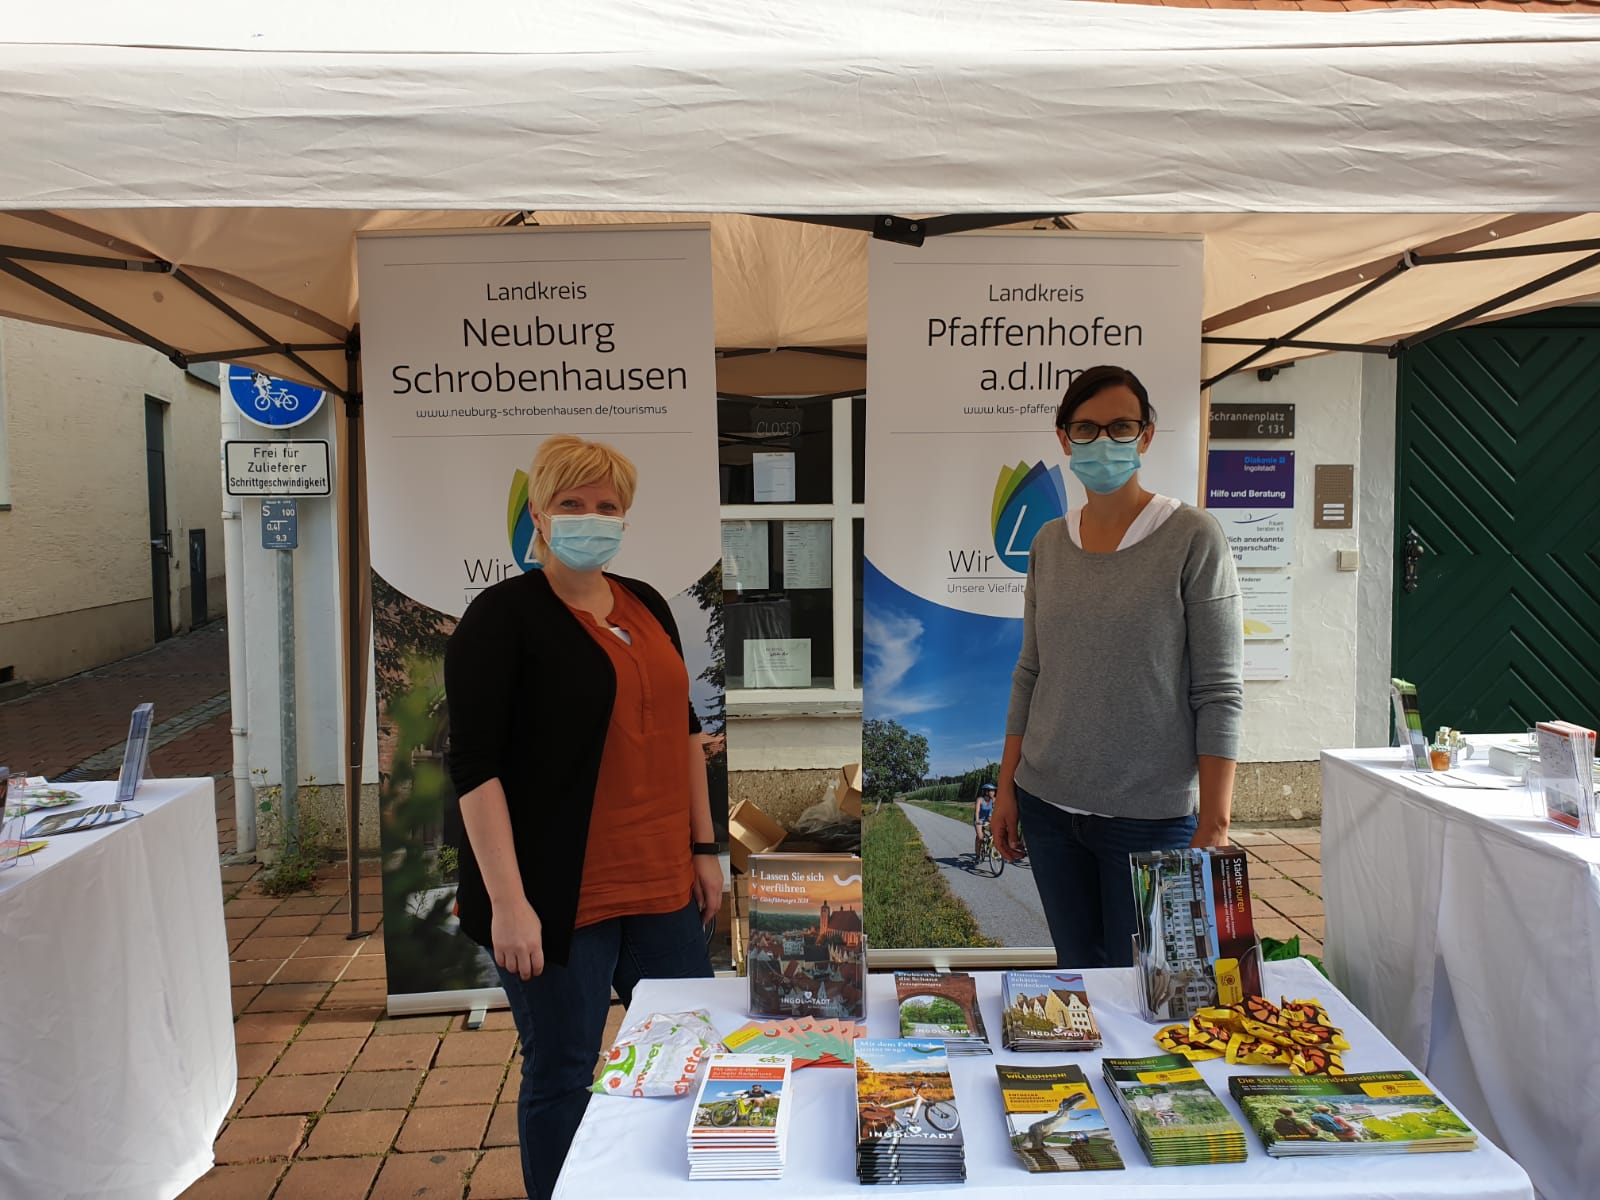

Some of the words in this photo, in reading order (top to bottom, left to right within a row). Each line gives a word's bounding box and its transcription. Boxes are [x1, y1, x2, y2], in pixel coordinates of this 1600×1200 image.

[486, 281, 587, 301] Landkreis
[988, 283, 1085, 302] Landkreis
[462, 316, 616, 353] Neuburg
[927, 317, 1143, 347] Pfaffenhofen
[391, 361, 688, 394] Schrobenhausen
[415, 404, 668, 419] www.neuburg-schrobenhausen.de/tourismus
[963, 403, 1059, 416] www.kus-pfaffen
[1209, 411, 1285, 423] Schrannenplatz
[1257, 424, 1265, 434] C
[1268, 424, 1285, 434] 131
[253, 447, 277, 458] Frei
[283, 447, 300, 458] für
[247, 462, 308, 473] Zulieferer
[230, 477, 326, 489] Schrittgeschwindigkeit
[1210, 489, 1229, 498] Hilfe
[1231, 490, 1247, 498] und
[1249, 490, 1286, 500] Beratung
[262, 505, 271, 517] S
[948, 550, 994, 572] Wir
[463, 558, 513, 583] Wir
[947, 583, 985, 594] Unsere
[987, 582, 1024, 593] Vielfalt
[760, 870, 789, 881] Lassen
[791, 871, 805, 881] Sie
[806, 872, 825, 882] sich
[760, 882, 806, 893] verführen
[1233, 857, 1245, 913] Städtetouren
[1237, 1077, 1255, 1085] Die
